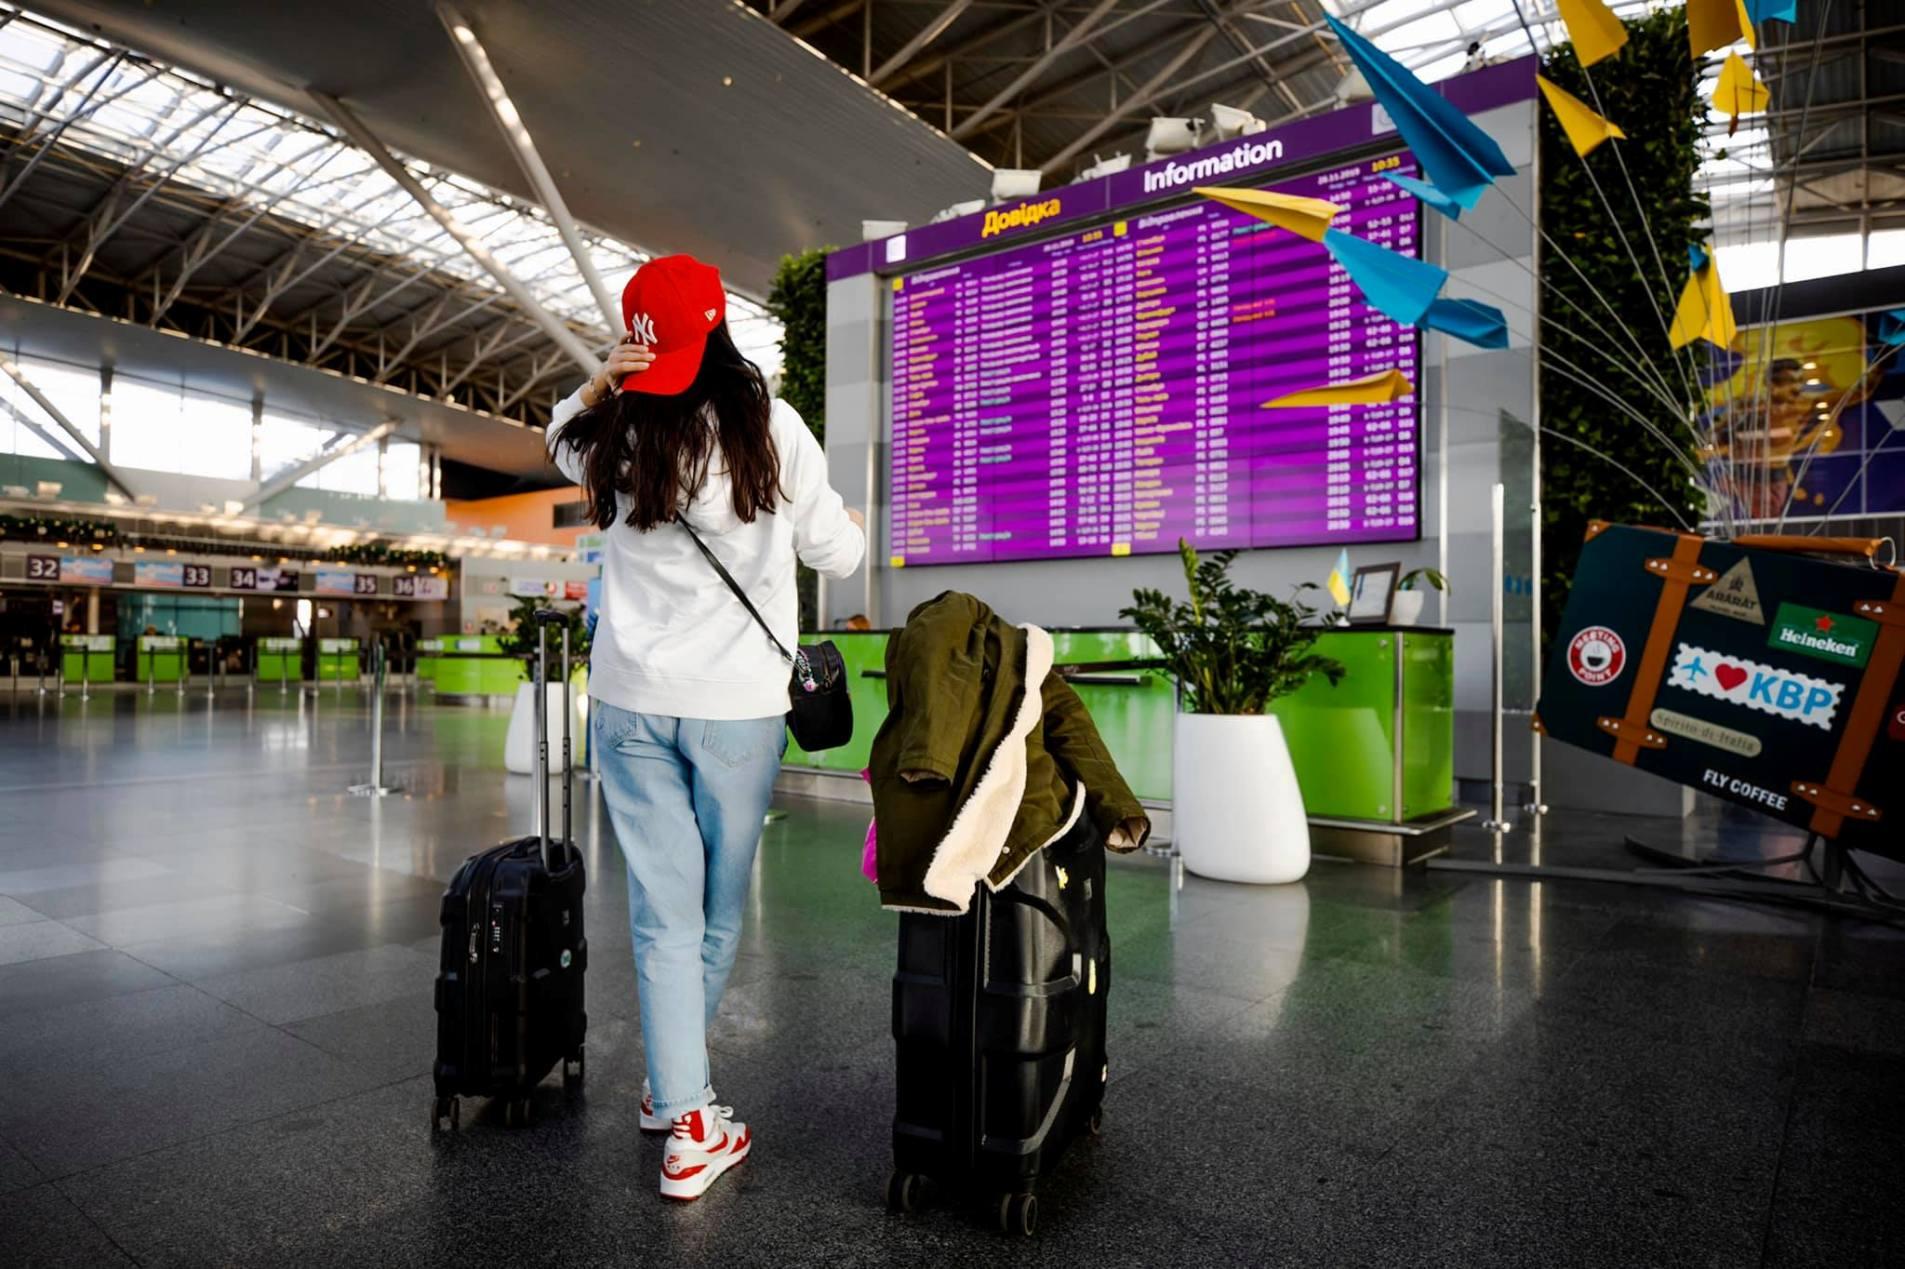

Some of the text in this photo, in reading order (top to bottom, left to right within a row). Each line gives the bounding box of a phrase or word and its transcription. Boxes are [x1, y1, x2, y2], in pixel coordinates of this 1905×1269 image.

[1144, 139, 1282, 192] Information
[981, 198, 1061, 238] Довідка
[632, 312, 659, 345] NY
[29, 558, 57, 577] 32
[186, 567, 209, 585] 33
[232, 570, 255, 587] 34
[357, 576, 376, 592] 35
[395, 578, 414, 594] 36
[1575, 630, 1620, 654] MEETING
[1779, 628, 1858, 657] Heineken
[1578, 666, 1612, 681] POINT
[1749, 672, 1832, 715] KBP
[1703, 768, 1788, 811] FLY COFFEE
